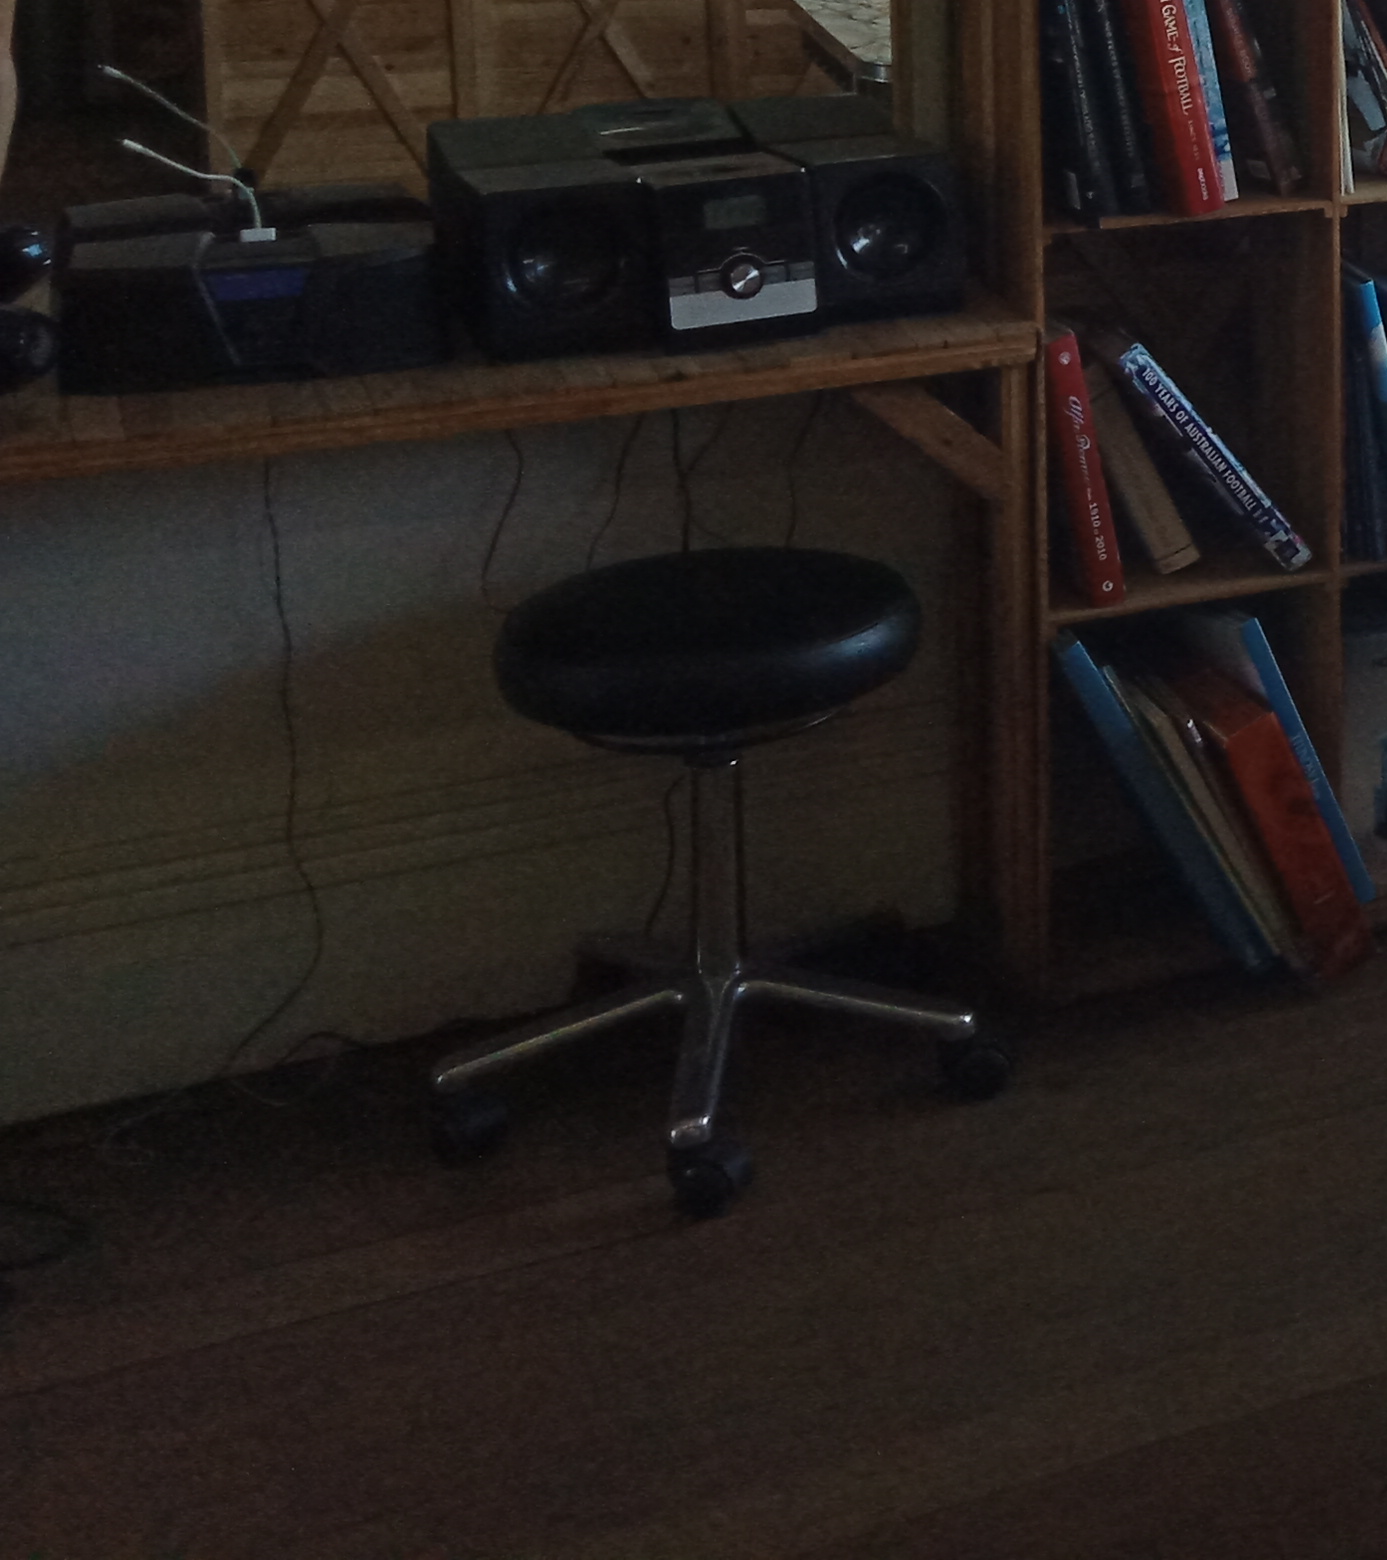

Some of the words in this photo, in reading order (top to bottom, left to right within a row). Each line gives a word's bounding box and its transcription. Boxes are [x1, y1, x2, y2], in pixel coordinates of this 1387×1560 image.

[1160, 2, 1181, 43] GAME
[1168, 55, 1195, 116] FOOTBALL
[1139, 366, 1160, 387] 100
[1152, 382, 1181, 413] YEARS
[1173, 409, 1190, 425] OF
[1183, 420, 1229, 474] AUSTRALIAN
[1221, 469, 1258, 511] FOOTBALL
[1093, 535, 1108, 562] 2010
